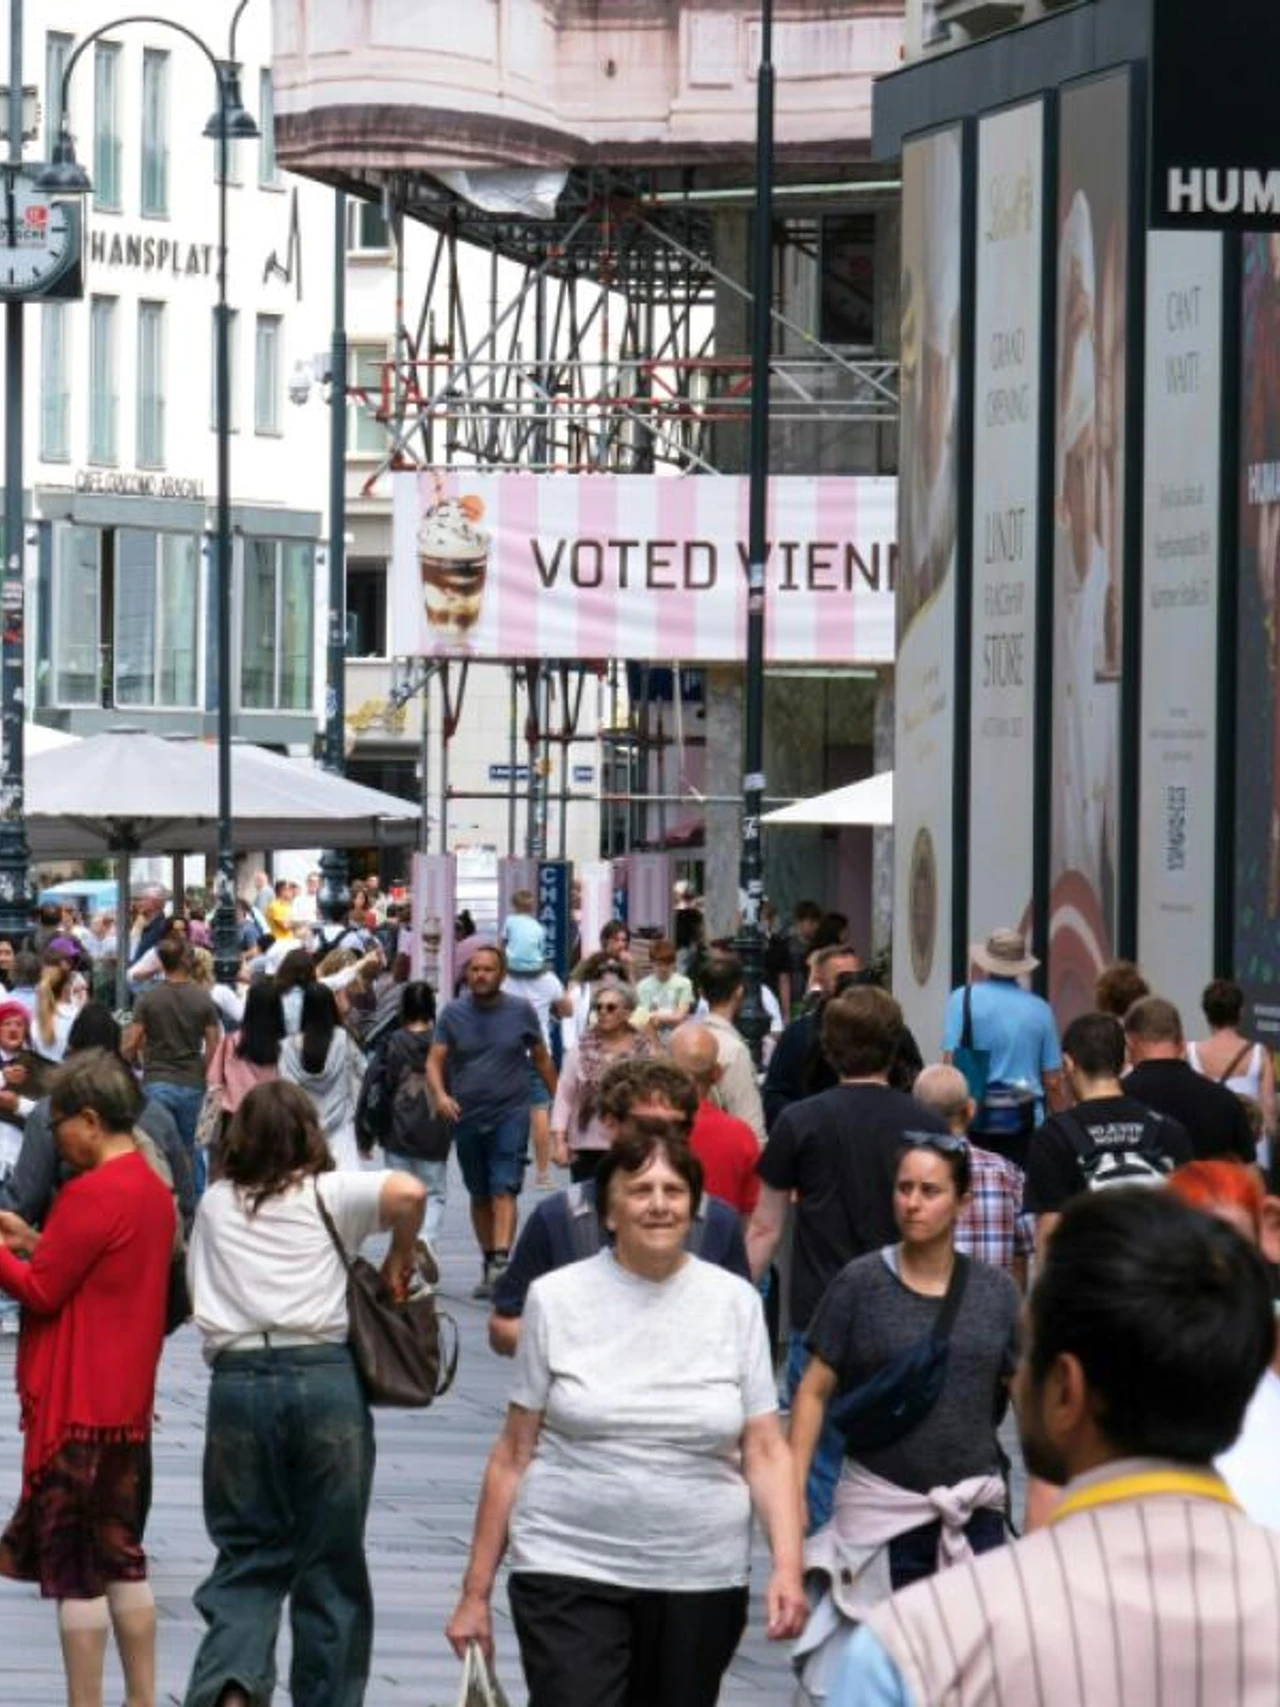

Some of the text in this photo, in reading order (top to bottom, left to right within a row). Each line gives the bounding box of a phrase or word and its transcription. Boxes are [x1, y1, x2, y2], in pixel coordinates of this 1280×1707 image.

[1168, 167, 1280, 213] HUM
[530, 539, 717, 590] VOTED
[539, 866, 558, 962] CHANG
